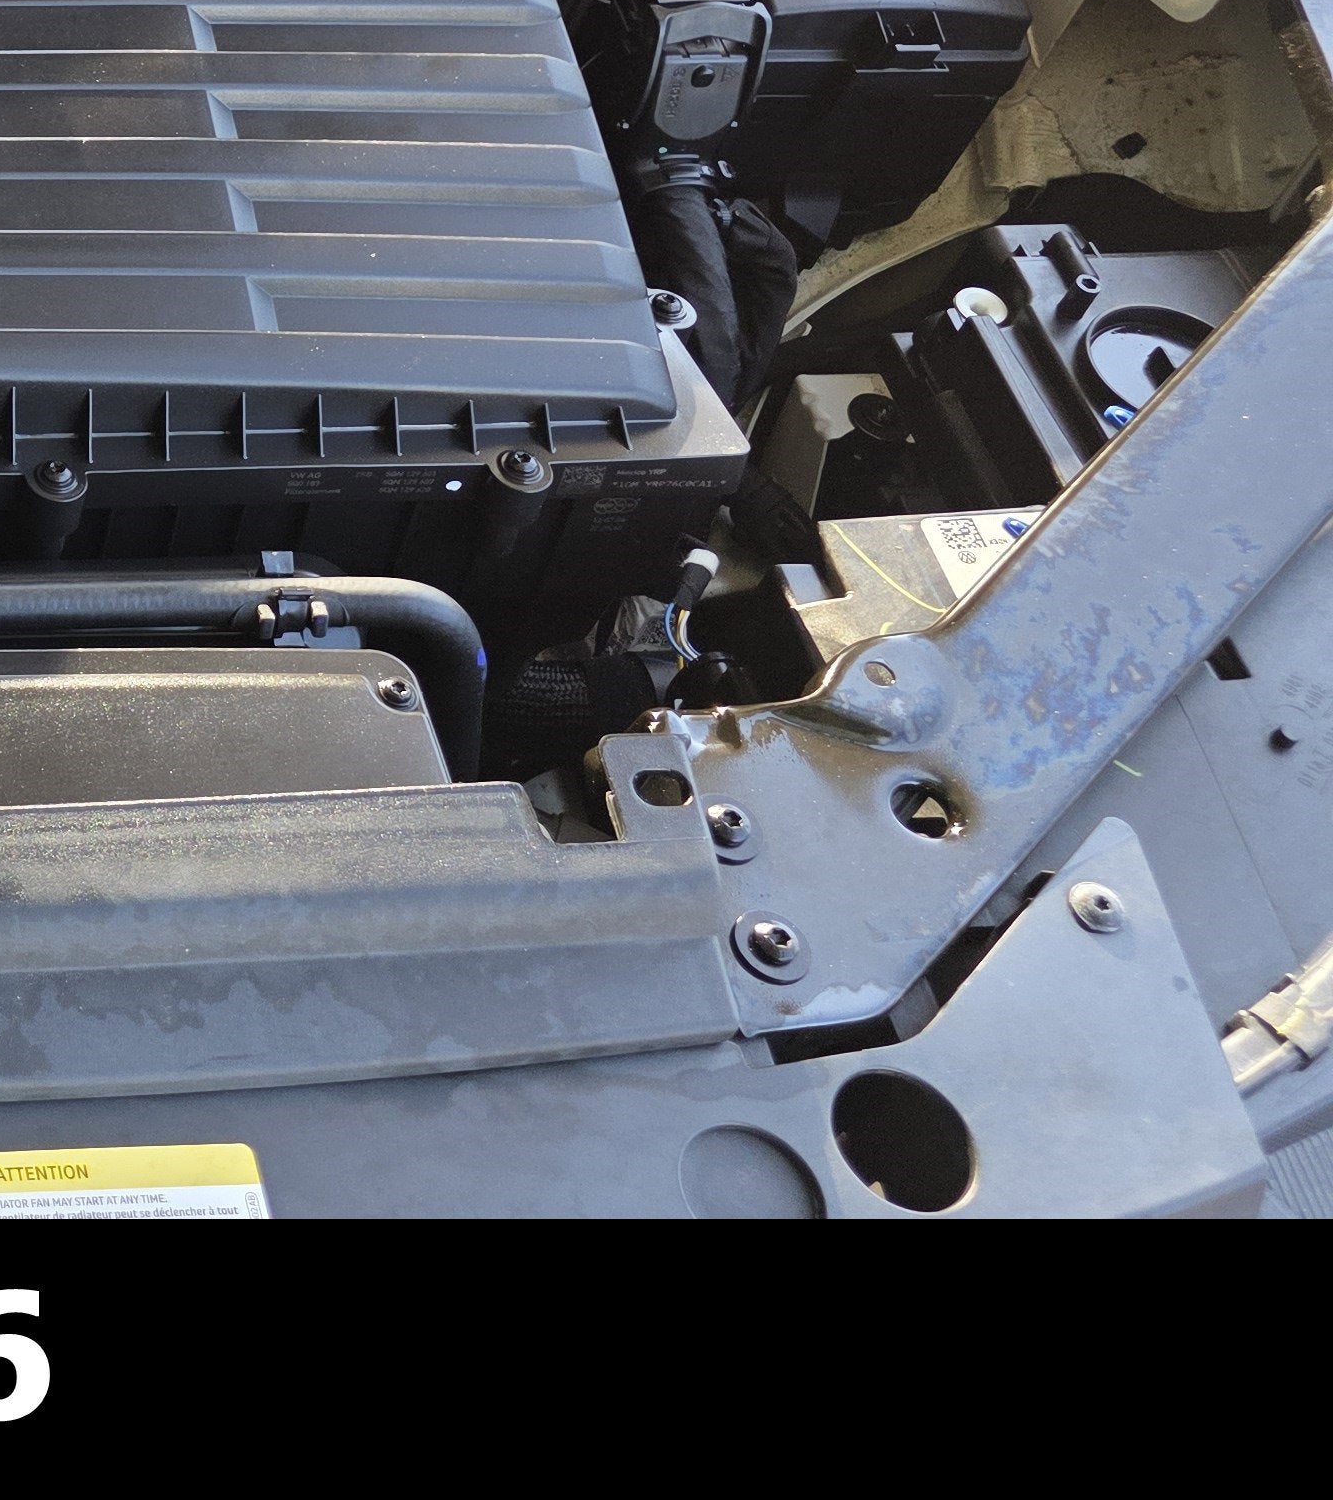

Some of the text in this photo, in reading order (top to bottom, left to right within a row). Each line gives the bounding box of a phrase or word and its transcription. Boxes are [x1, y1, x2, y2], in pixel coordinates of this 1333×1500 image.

[31, 1199, 51, 1209] FAN
[52, 1198, 73, 1208] MAY
[75, 1196, 104, 1206] START
[106, 1195, 120, 1205] AT
[120, 1195, 140, 1204] ANY
[141, 1194, 168, 1203] TIME.
[67, 1208, 112, 1219] radiateur
[140, 1210, 151, 1218] se
[153, 1206, 206, 1218] déclencher
[217, 1206, 239, 1215] tout
